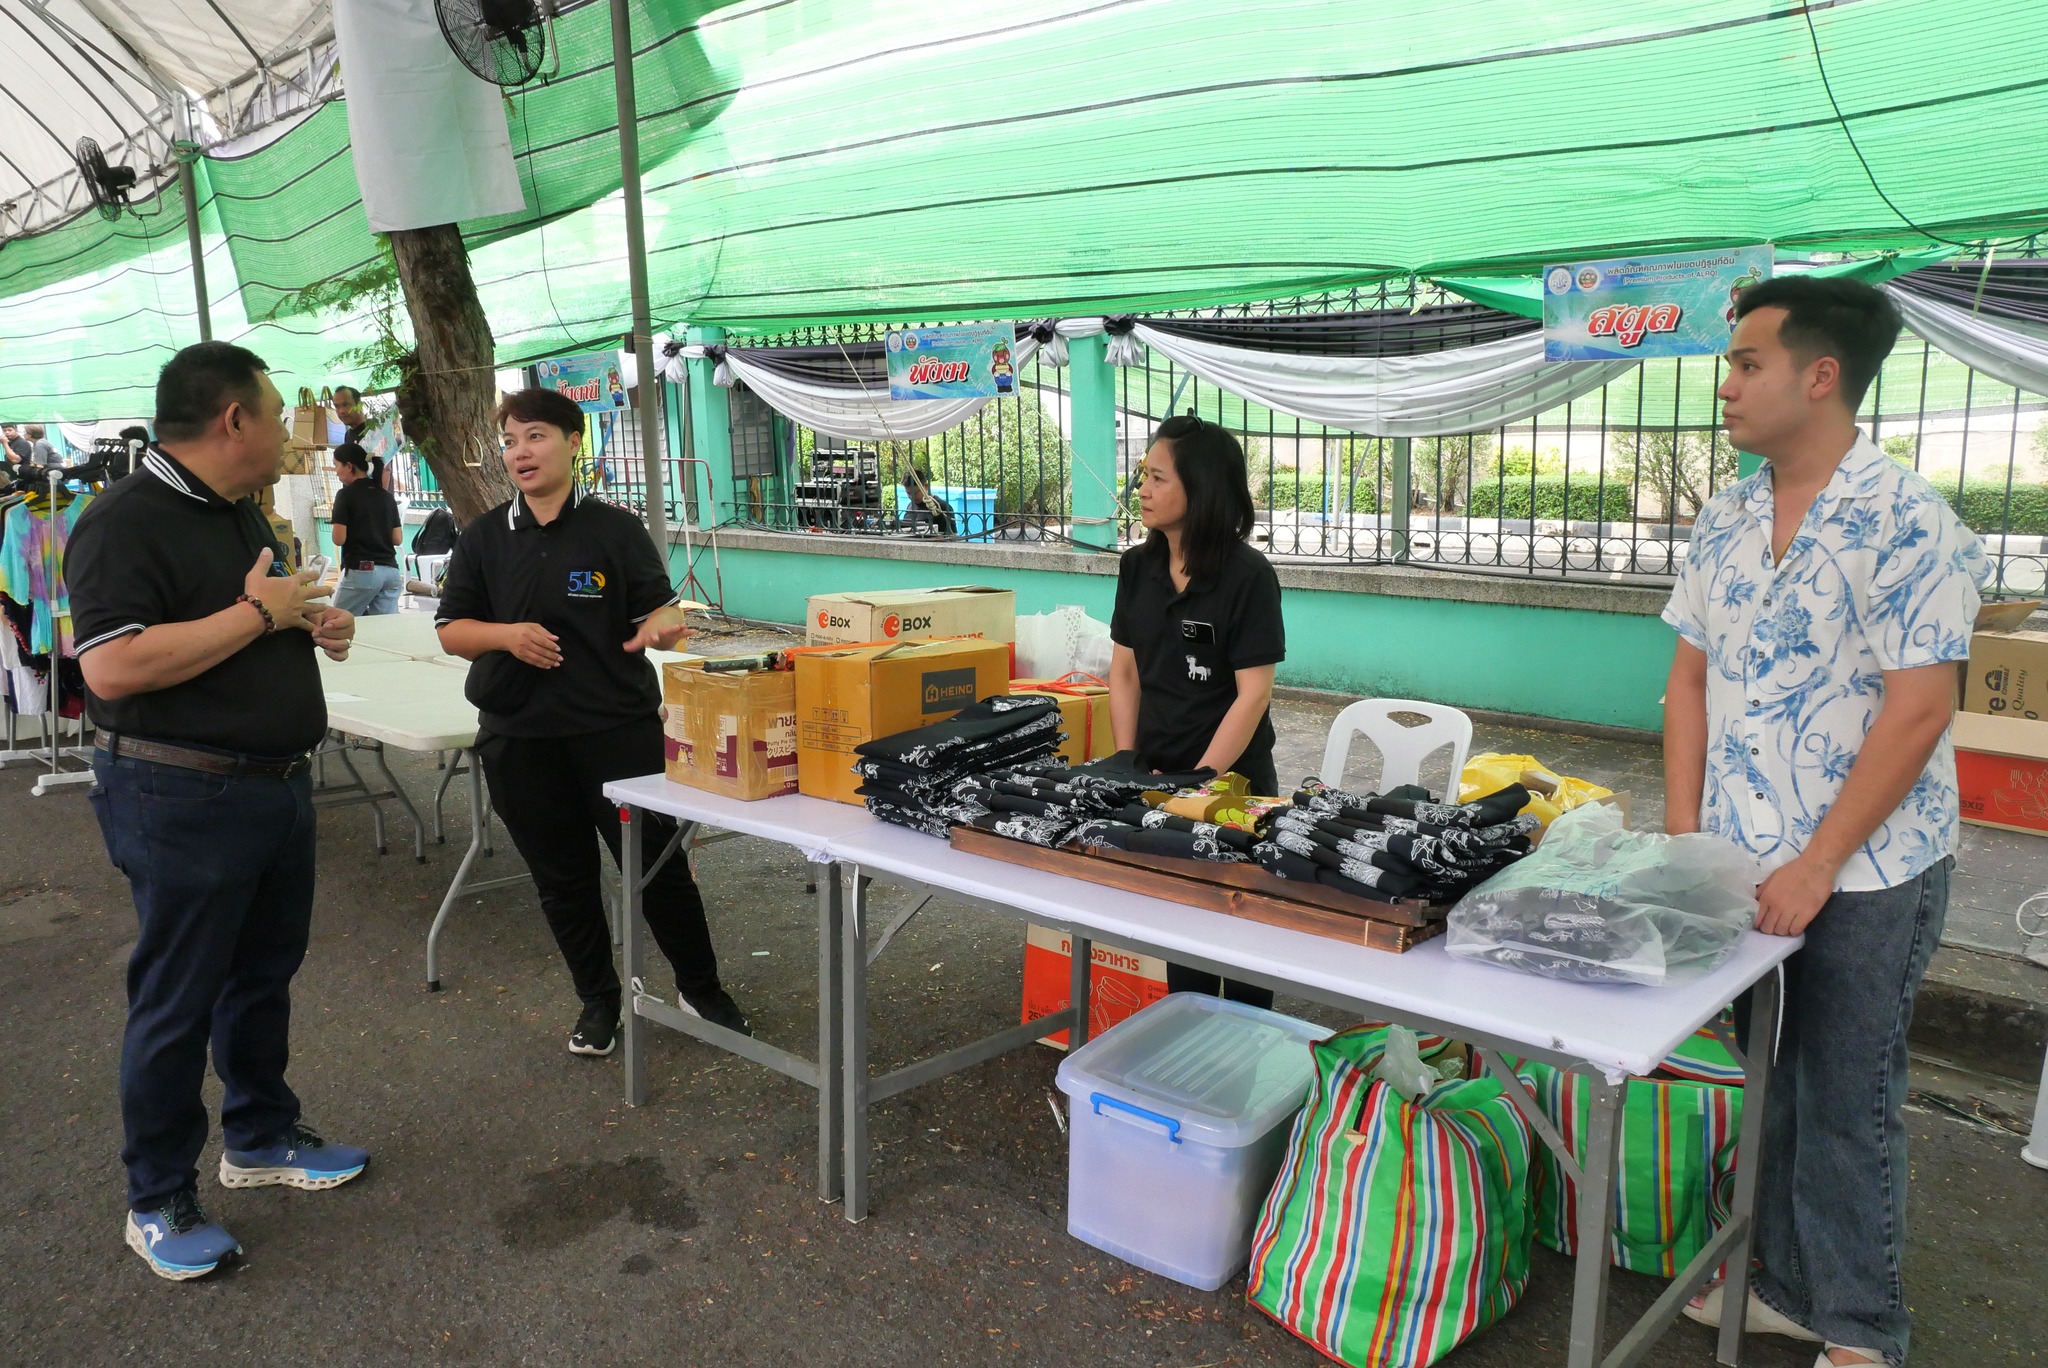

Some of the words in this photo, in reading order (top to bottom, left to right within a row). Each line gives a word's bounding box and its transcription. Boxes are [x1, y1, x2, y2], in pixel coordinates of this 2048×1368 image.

[1588, 303, 1682, 347] สตูล
[568, 571, 593, 592] 51
[2012, 669, 2028, 711] Quality
[768, 744, 797, 756] クリスピー
